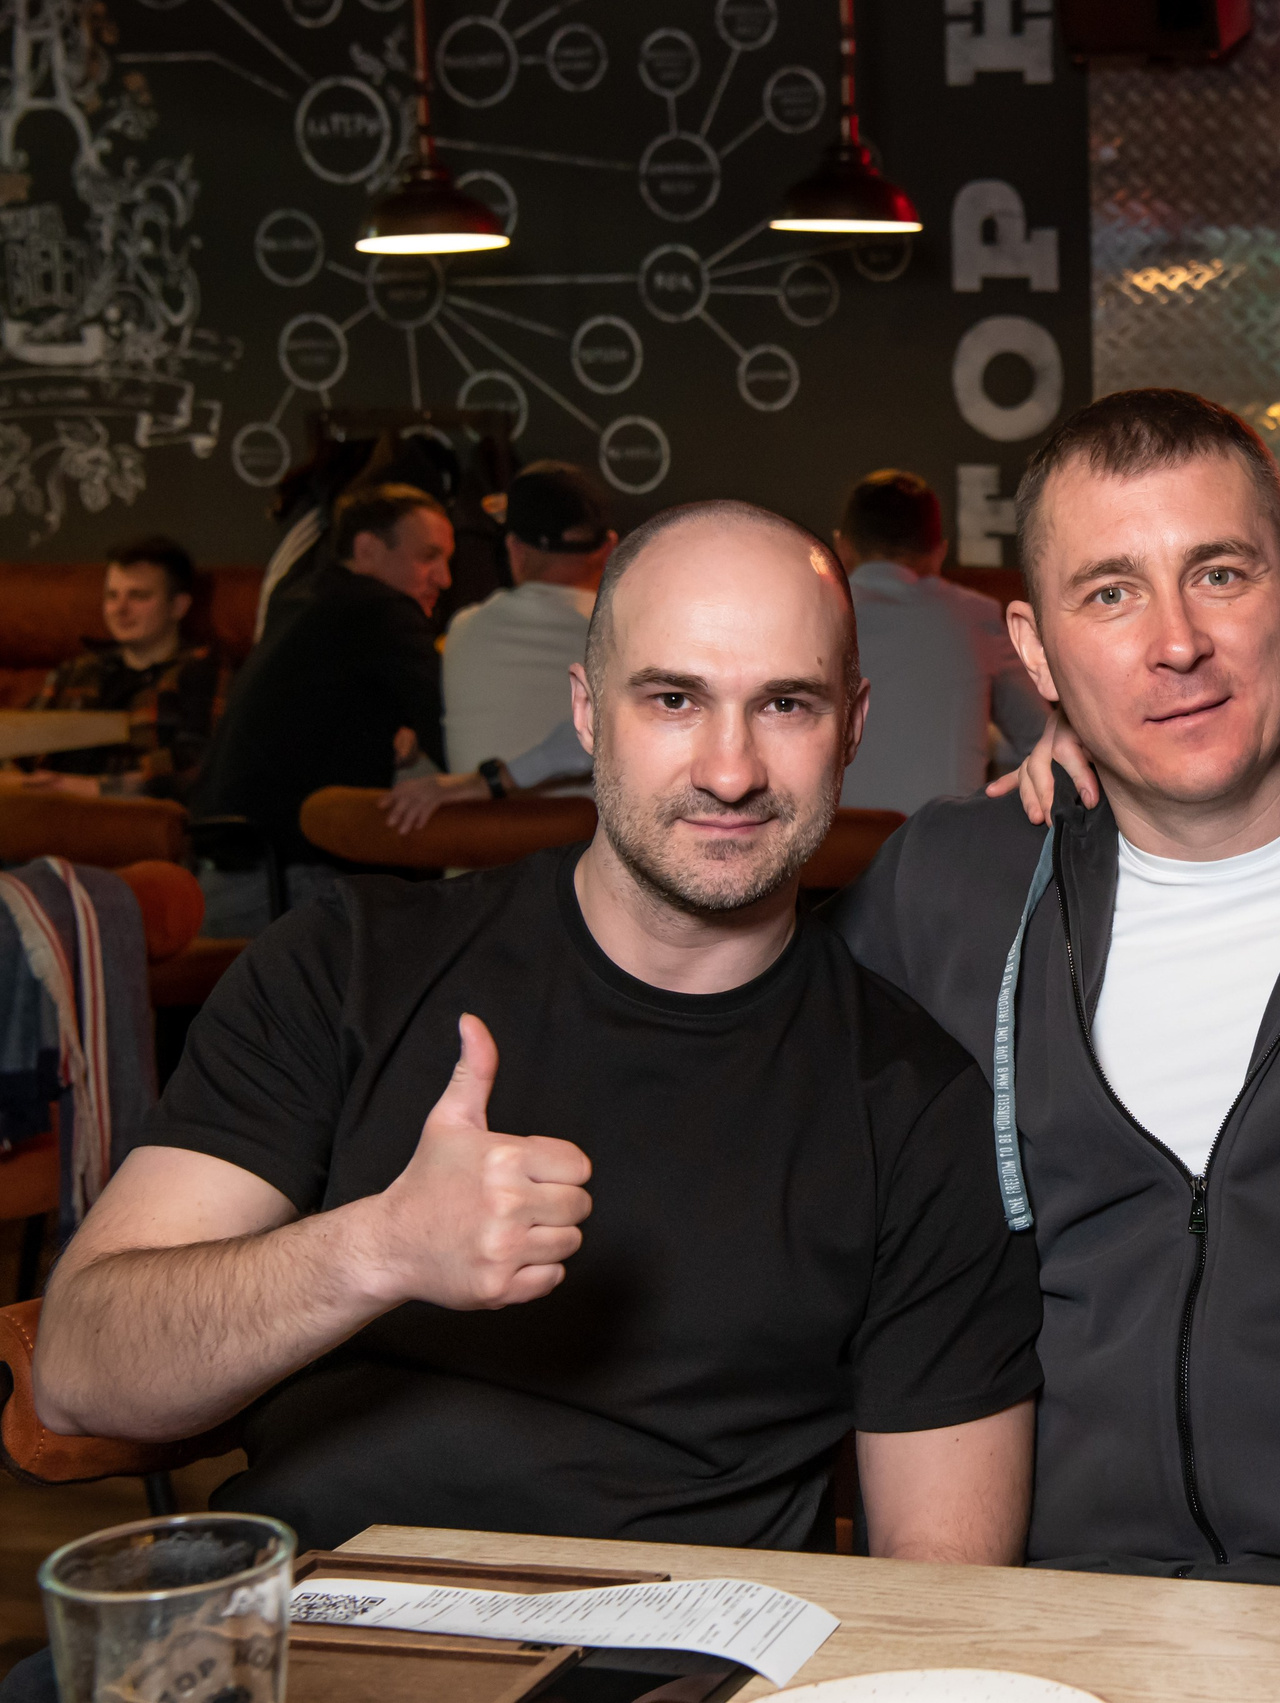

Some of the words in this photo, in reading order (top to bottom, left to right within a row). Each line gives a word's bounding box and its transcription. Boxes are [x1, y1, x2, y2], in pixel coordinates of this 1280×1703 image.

[951, 179, 1064, 567] TOP
[1002, 974, 1013, 986] TO
[998, 987, 1011, 1023] FREEDOM
[996, 1026, 1009, 1043] ONE
[996, 1045, 1009, 1064] LOVE
[996, 1094, 1011, 1131] YOURSELF
[998, 1134, 1012, 1144] BE
[999, 1147, 1014, 1158] TO
[1001, 1160, 1021, 1195] FREEDOM
[1008, 1197, 1025, 1215] ONE
